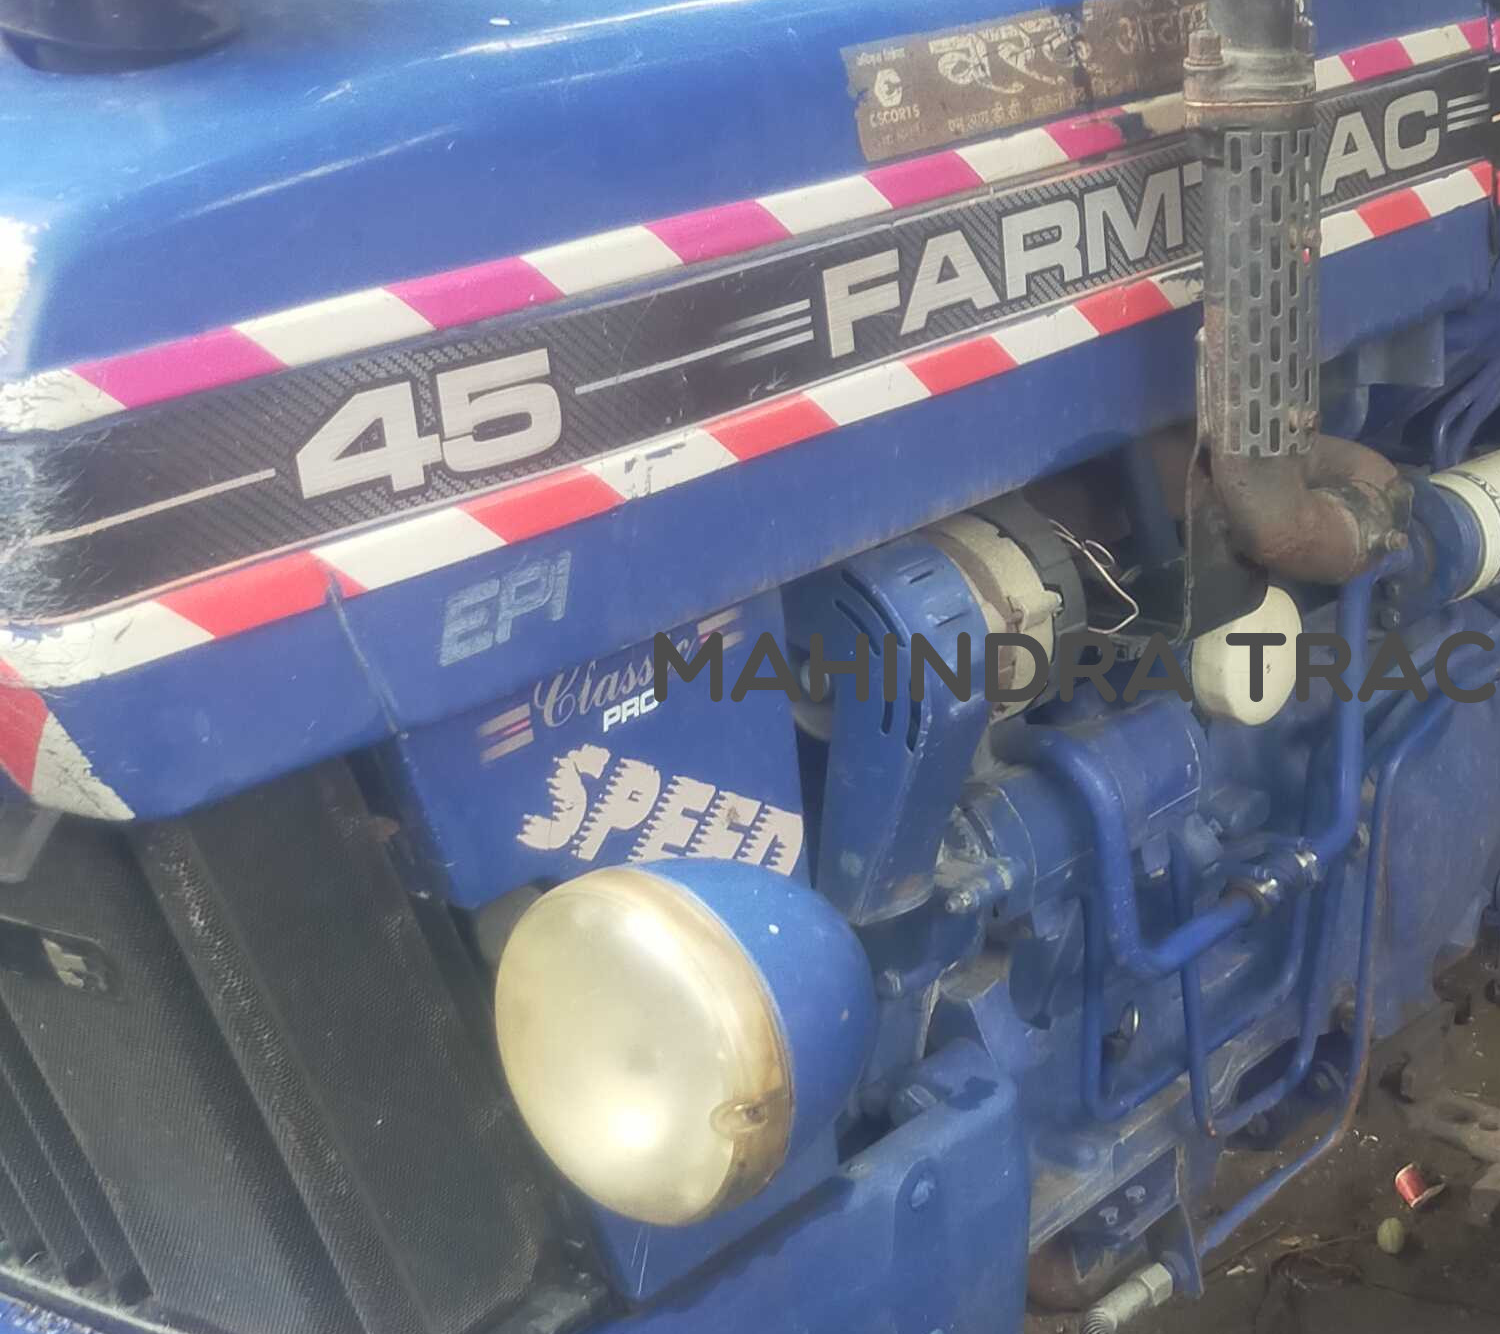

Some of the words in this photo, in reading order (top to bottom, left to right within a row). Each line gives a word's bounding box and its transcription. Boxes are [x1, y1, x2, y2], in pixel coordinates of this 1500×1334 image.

[295, 348, 564, 500] 45
[822, 88, 1440, 359] FARMAC
[439, 550, 573, 667] EPI
[602, 687, 661, 733] PRO
[516, 743, 805, 877] SPEED
